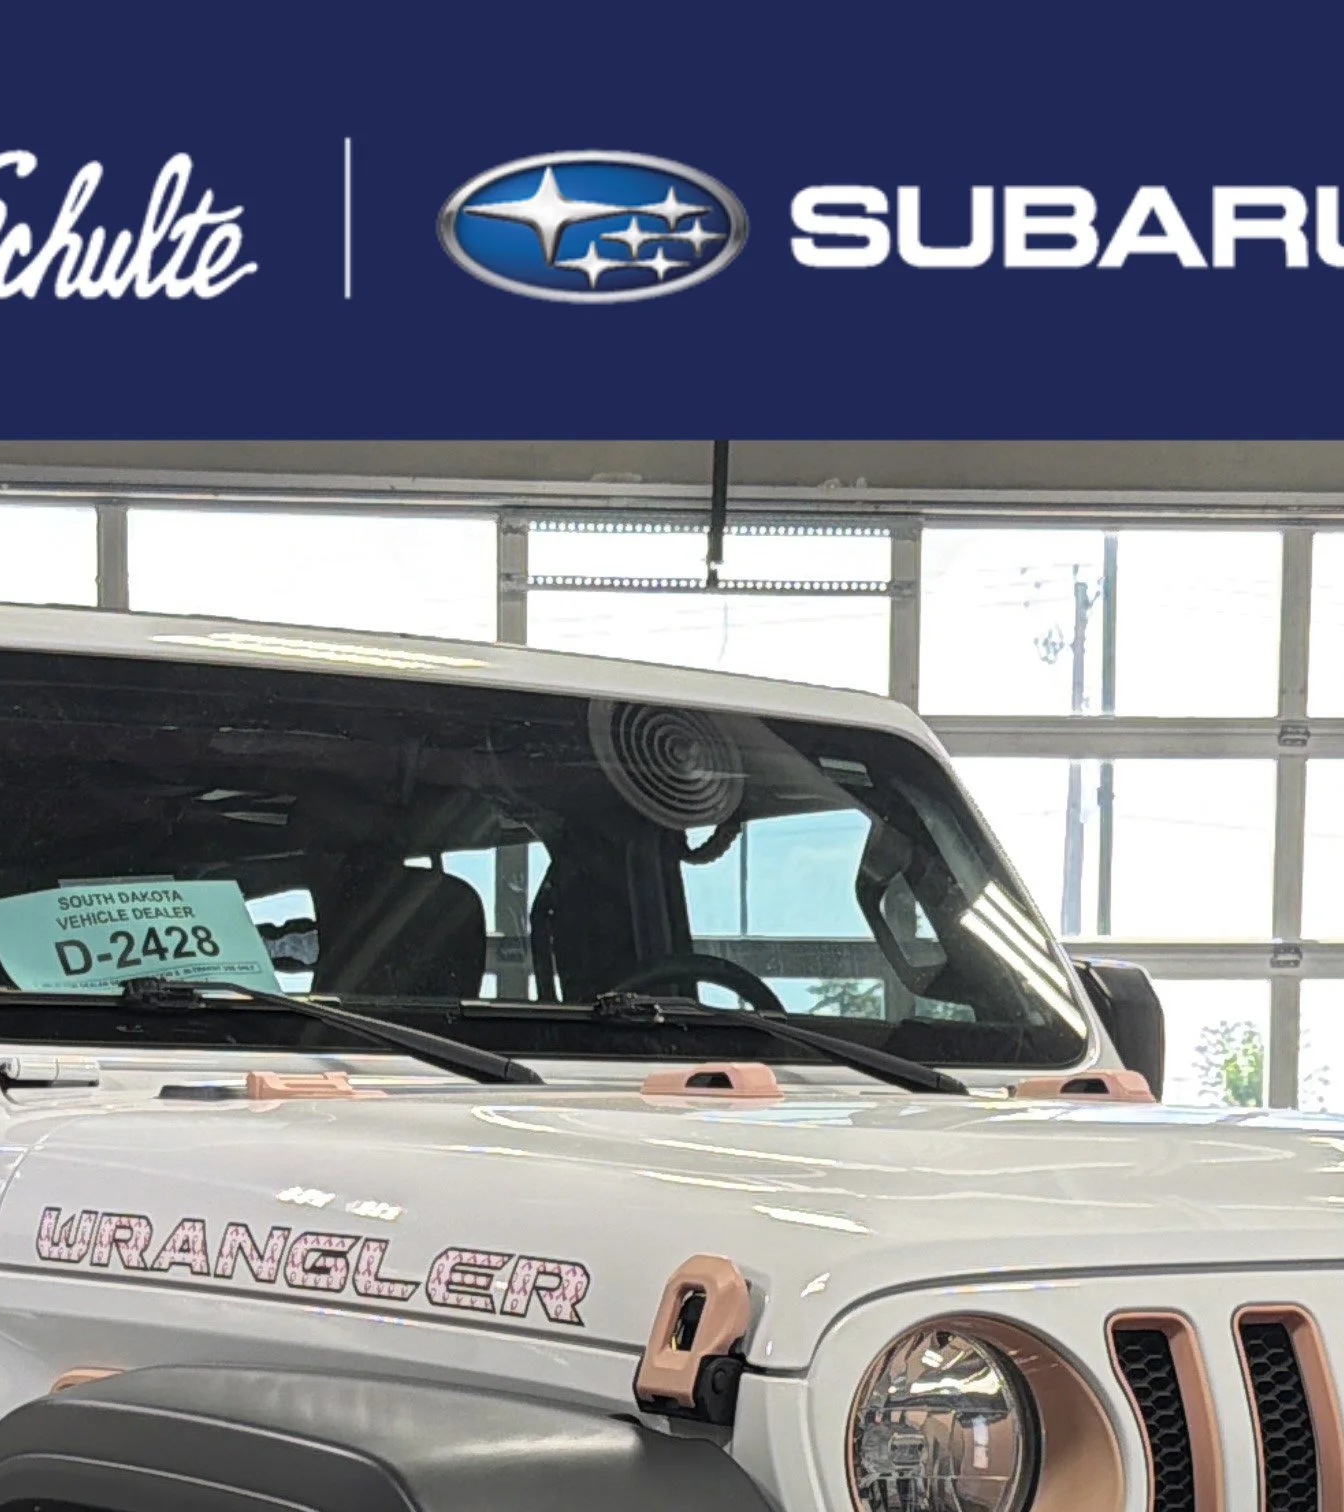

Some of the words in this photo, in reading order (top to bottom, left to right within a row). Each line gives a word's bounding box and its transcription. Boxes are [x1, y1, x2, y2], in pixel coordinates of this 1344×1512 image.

[56, 908, 130, 931] VEHICLE
[131, 905, 196, 920] DEALER
[57, 892, 116, 911] SOUTH
[117, 889, 184, 904] DAKOTA
[55, 925, 221, 977] D-2428
[35, 1206, 592, 1327] WRANGLER
